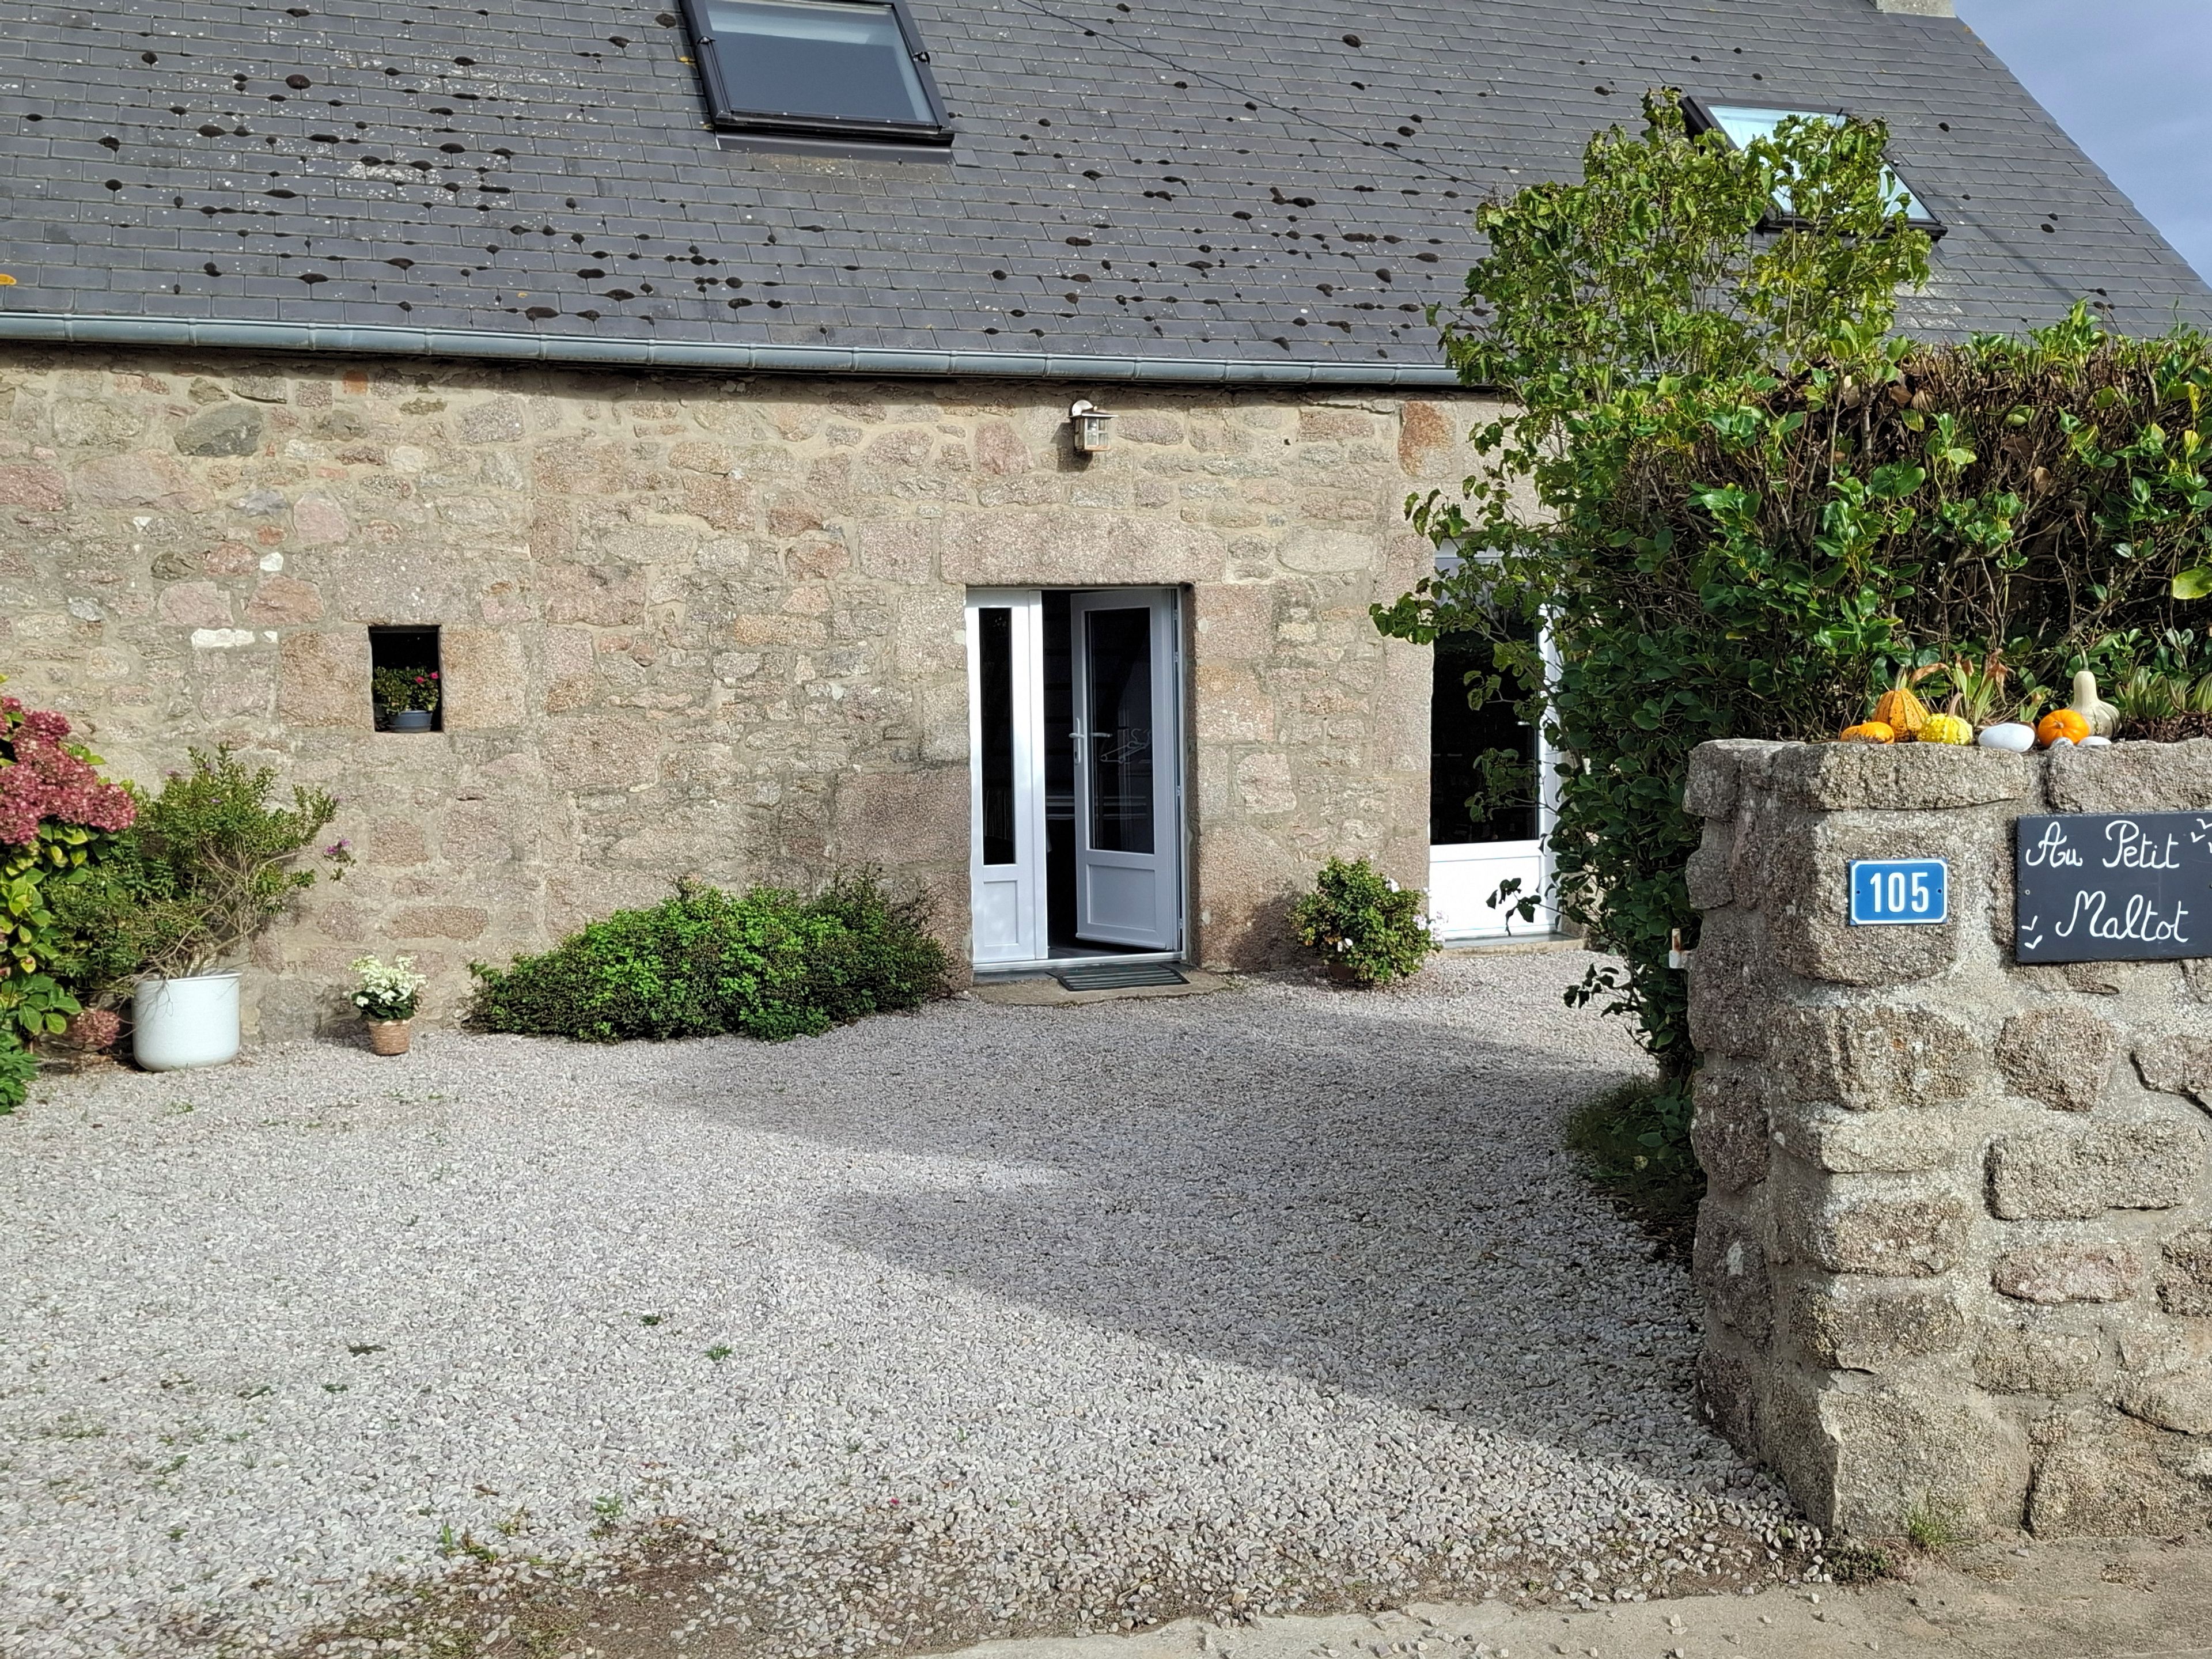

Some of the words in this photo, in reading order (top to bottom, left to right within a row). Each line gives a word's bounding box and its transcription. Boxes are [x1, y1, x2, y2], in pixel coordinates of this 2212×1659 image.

[2026, 821, 2083, 868] Au
[2102, 820, 2179, 869] Petit
[1870, 872, 1929, 912] 105
[2055, 891, 2188, 942] Maltot
